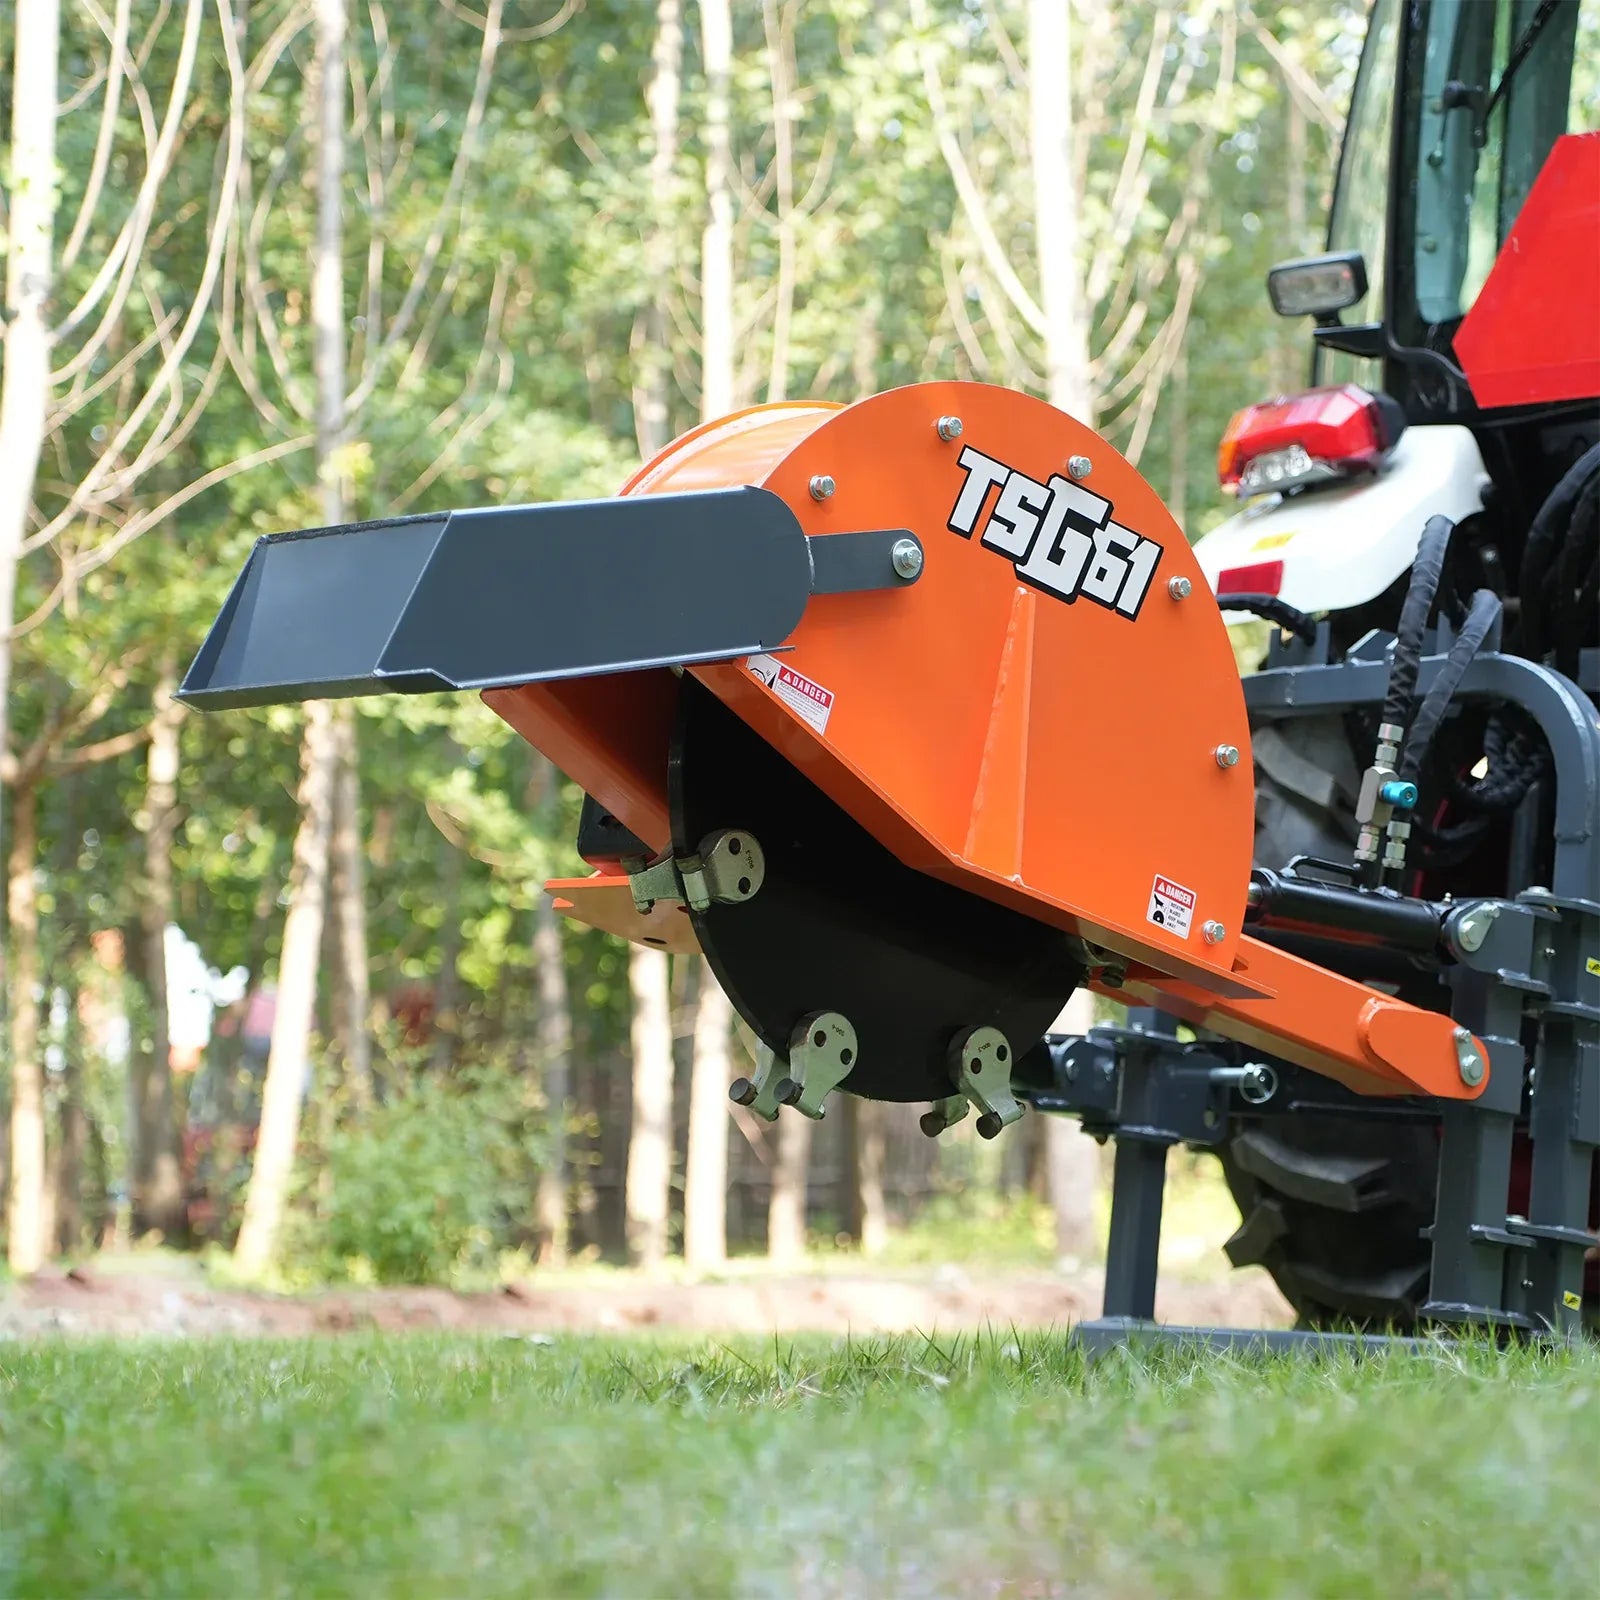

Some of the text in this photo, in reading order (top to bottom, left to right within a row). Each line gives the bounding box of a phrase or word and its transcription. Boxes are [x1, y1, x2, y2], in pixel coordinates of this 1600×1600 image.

[946, 443, 1164, 622] TSG61
[792, 676, 827, 704] DANGER
[1166, 885, 1192, 906] DANGER
